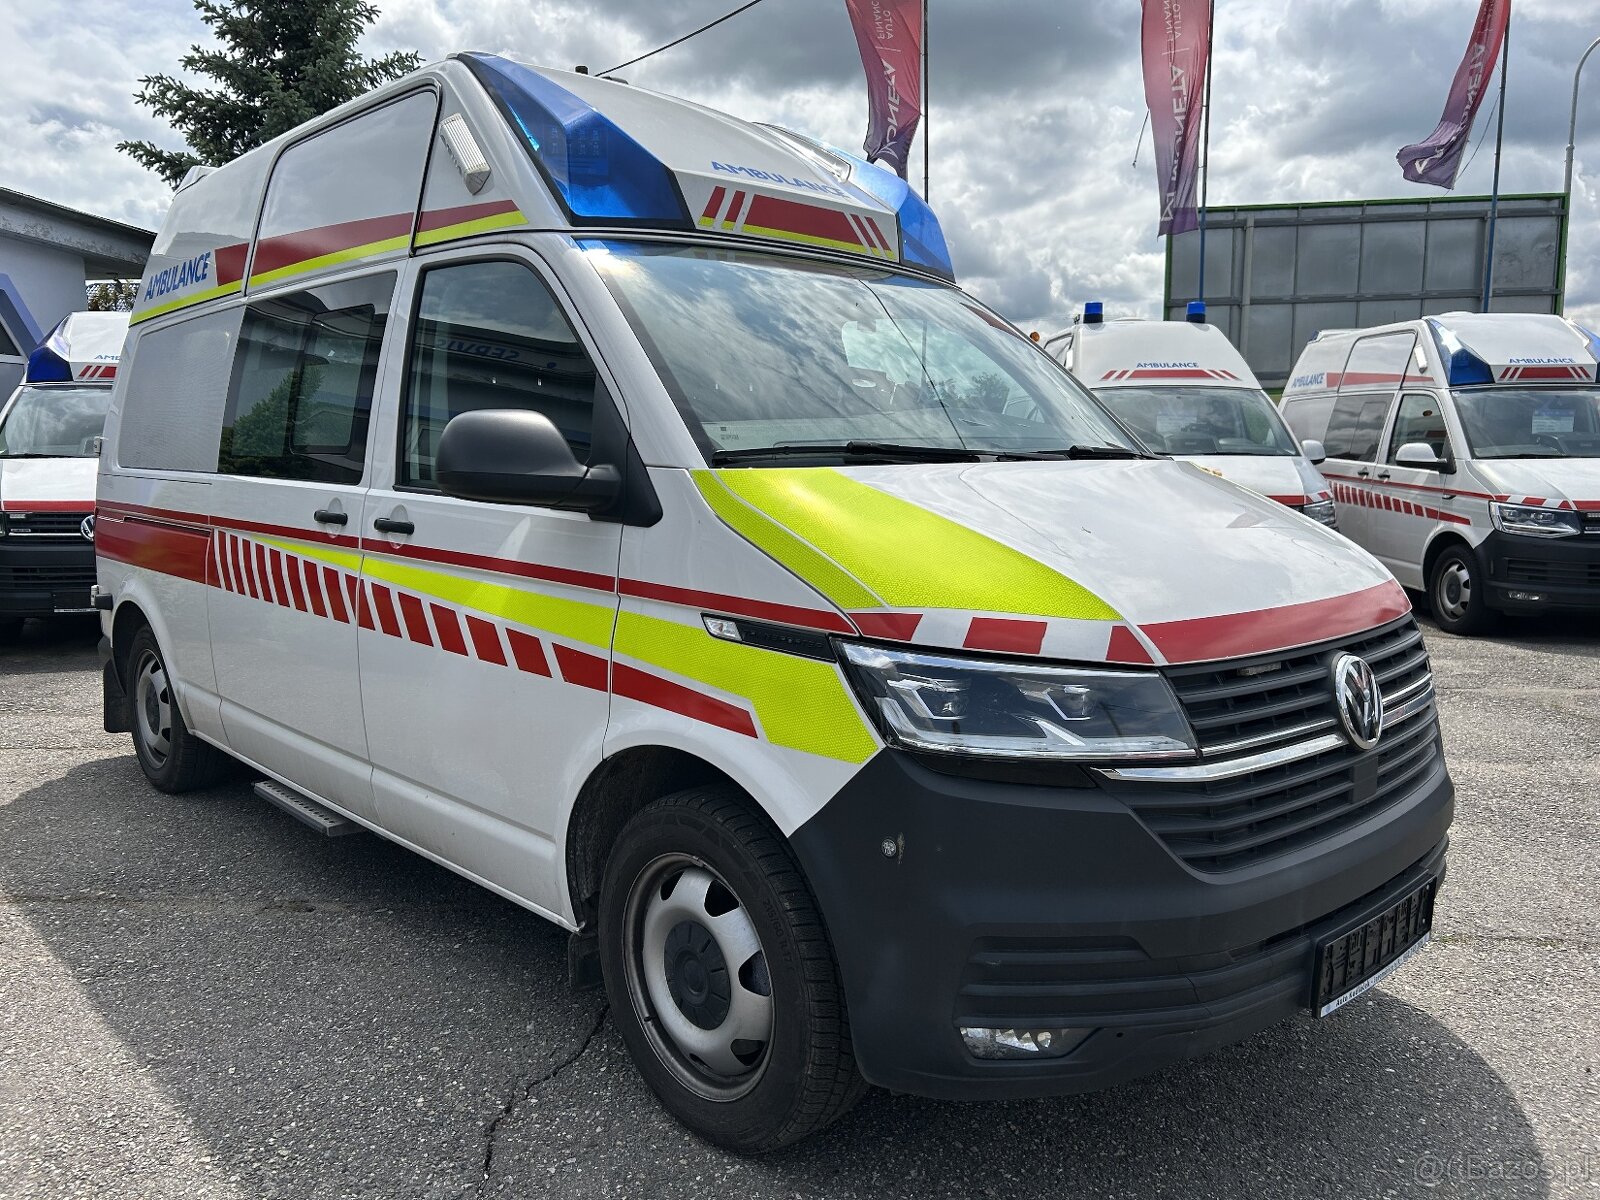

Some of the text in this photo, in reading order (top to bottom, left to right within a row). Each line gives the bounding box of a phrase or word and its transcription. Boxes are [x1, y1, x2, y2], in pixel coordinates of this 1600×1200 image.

[711, 161, 851, 199] AMBULANCE
[144, 252, 211, 302] AMBULANCE
[1291, 372, 1325, 389] AMBULANCE
